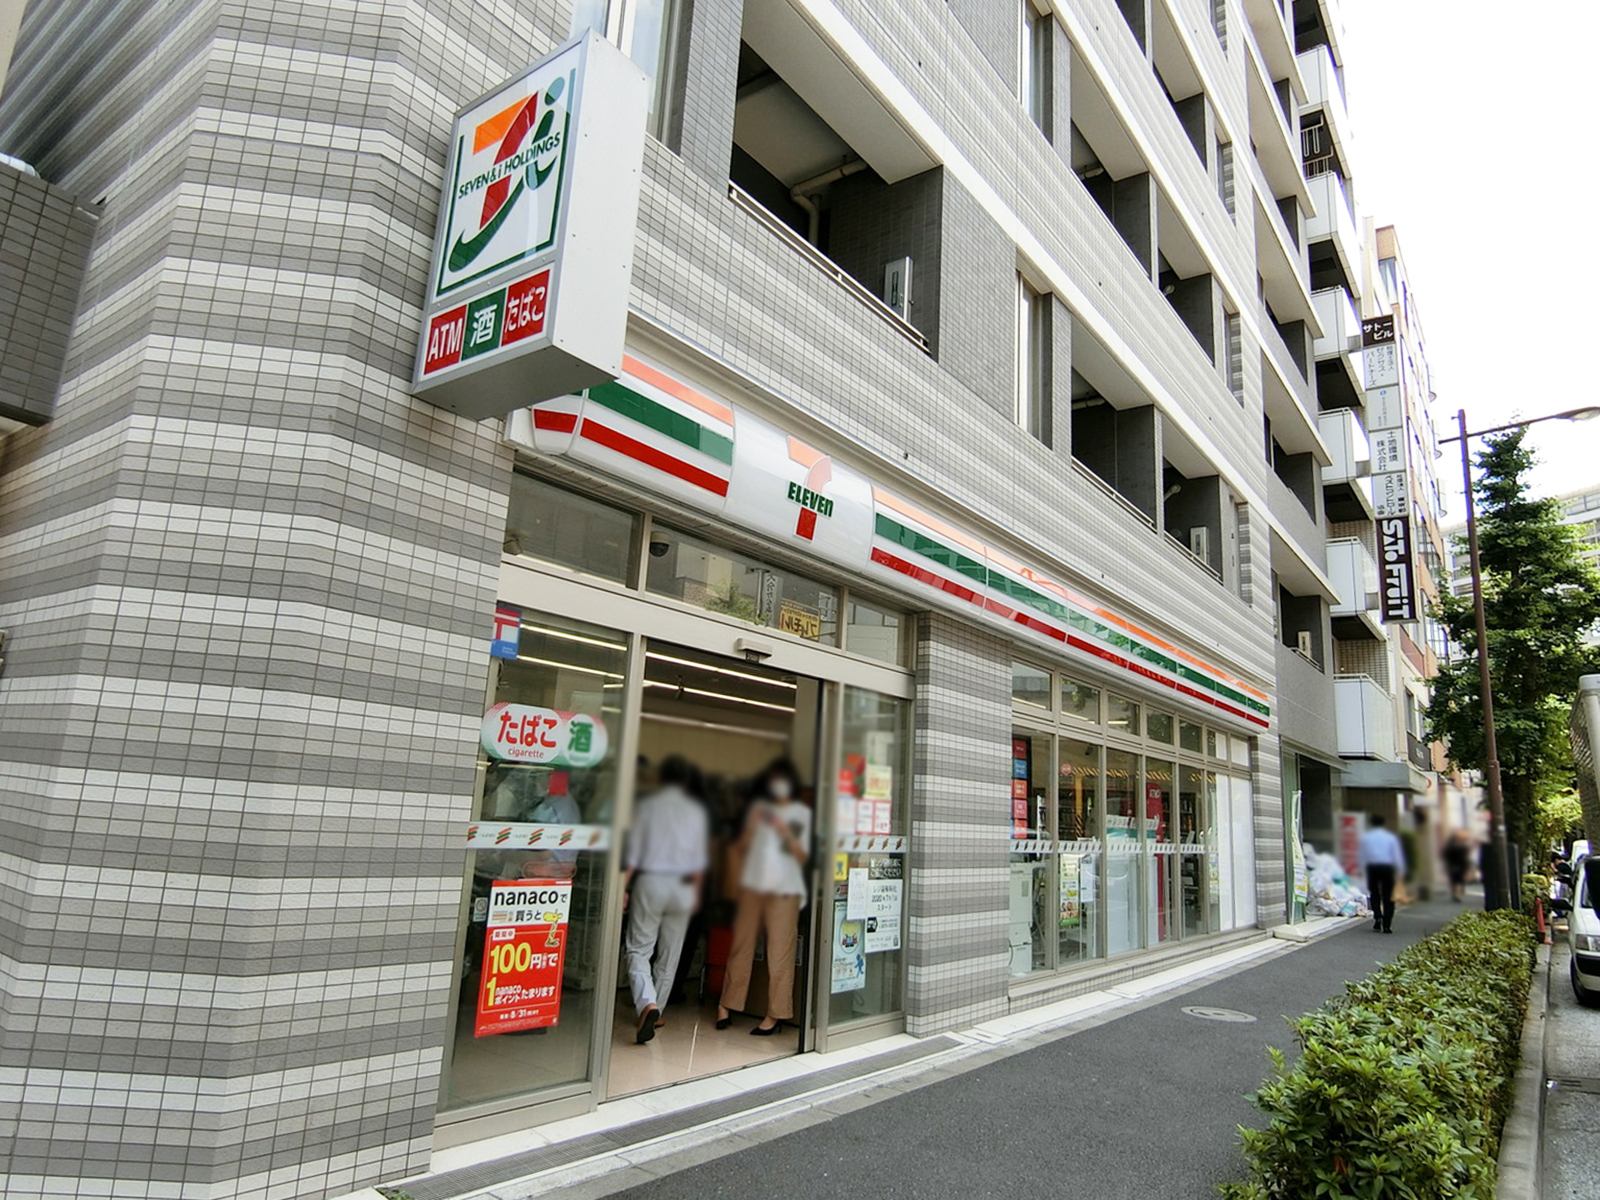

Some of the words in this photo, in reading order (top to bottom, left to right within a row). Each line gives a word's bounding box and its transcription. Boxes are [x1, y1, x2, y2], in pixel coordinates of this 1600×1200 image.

[504, 131, 561, 175] HOLDINGS
[470, 303, 498, 348] 酒
[505, 285, 547, 334] たばこ
[427, 317, 464, 363] ATM
[1362, 321, 1392, 333] サトー
[1373, 330, 1393, 340] ビル
[1377, 440, 1387, 470] 株式会社
[498, 710, 558, 748] たばこ
[568, 720, 594, 754] 酒
[508, 748, 545, 759] cigarette
[515, 909, 542, 922] 買うと
[494, 995, 521, 1006] ポイント
[521, 986, 556, 1000] たまります
